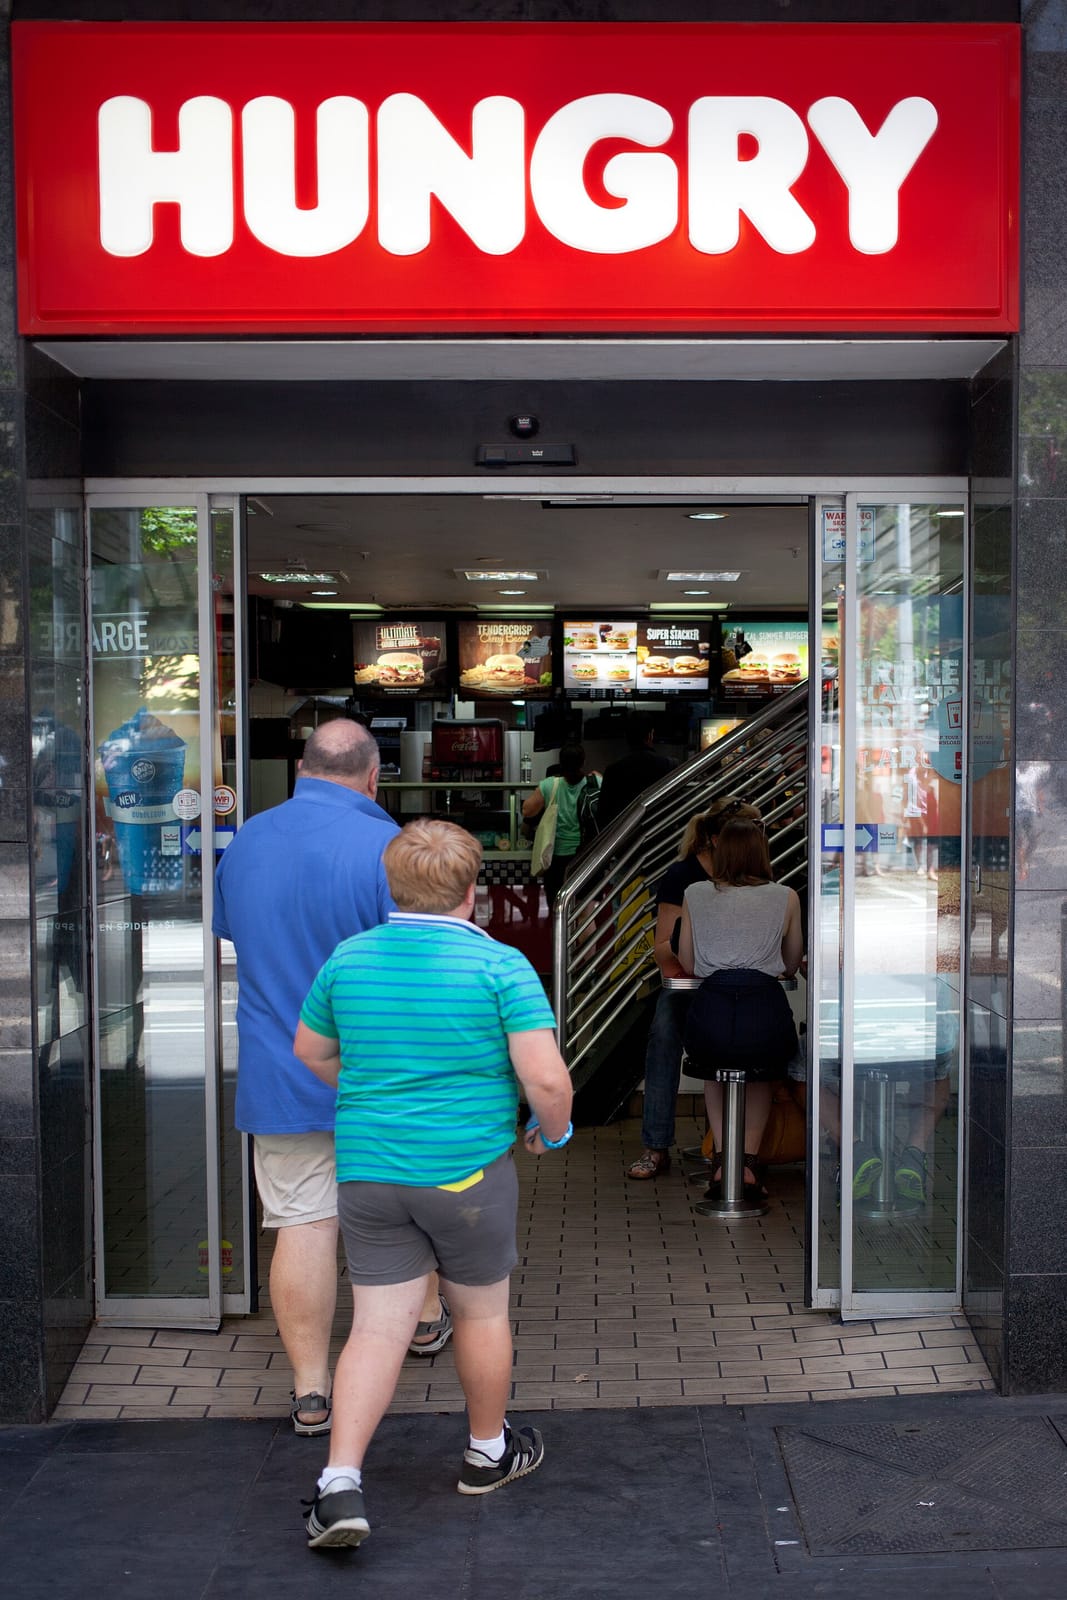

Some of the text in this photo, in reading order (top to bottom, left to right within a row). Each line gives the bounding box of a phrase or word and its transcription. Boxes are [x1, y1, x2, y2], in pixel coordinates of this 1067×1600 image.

[98, 92, 939, 258] HUNGRY
[825, 512, 872, 520] WARNG
[477, 624, 533, 635] TENDERCRISP
[646, 628, 700, 640] SUPER STACKER
[118, 794, 136, 806] NEW
[116, 922, 154, 931] SPIDER
